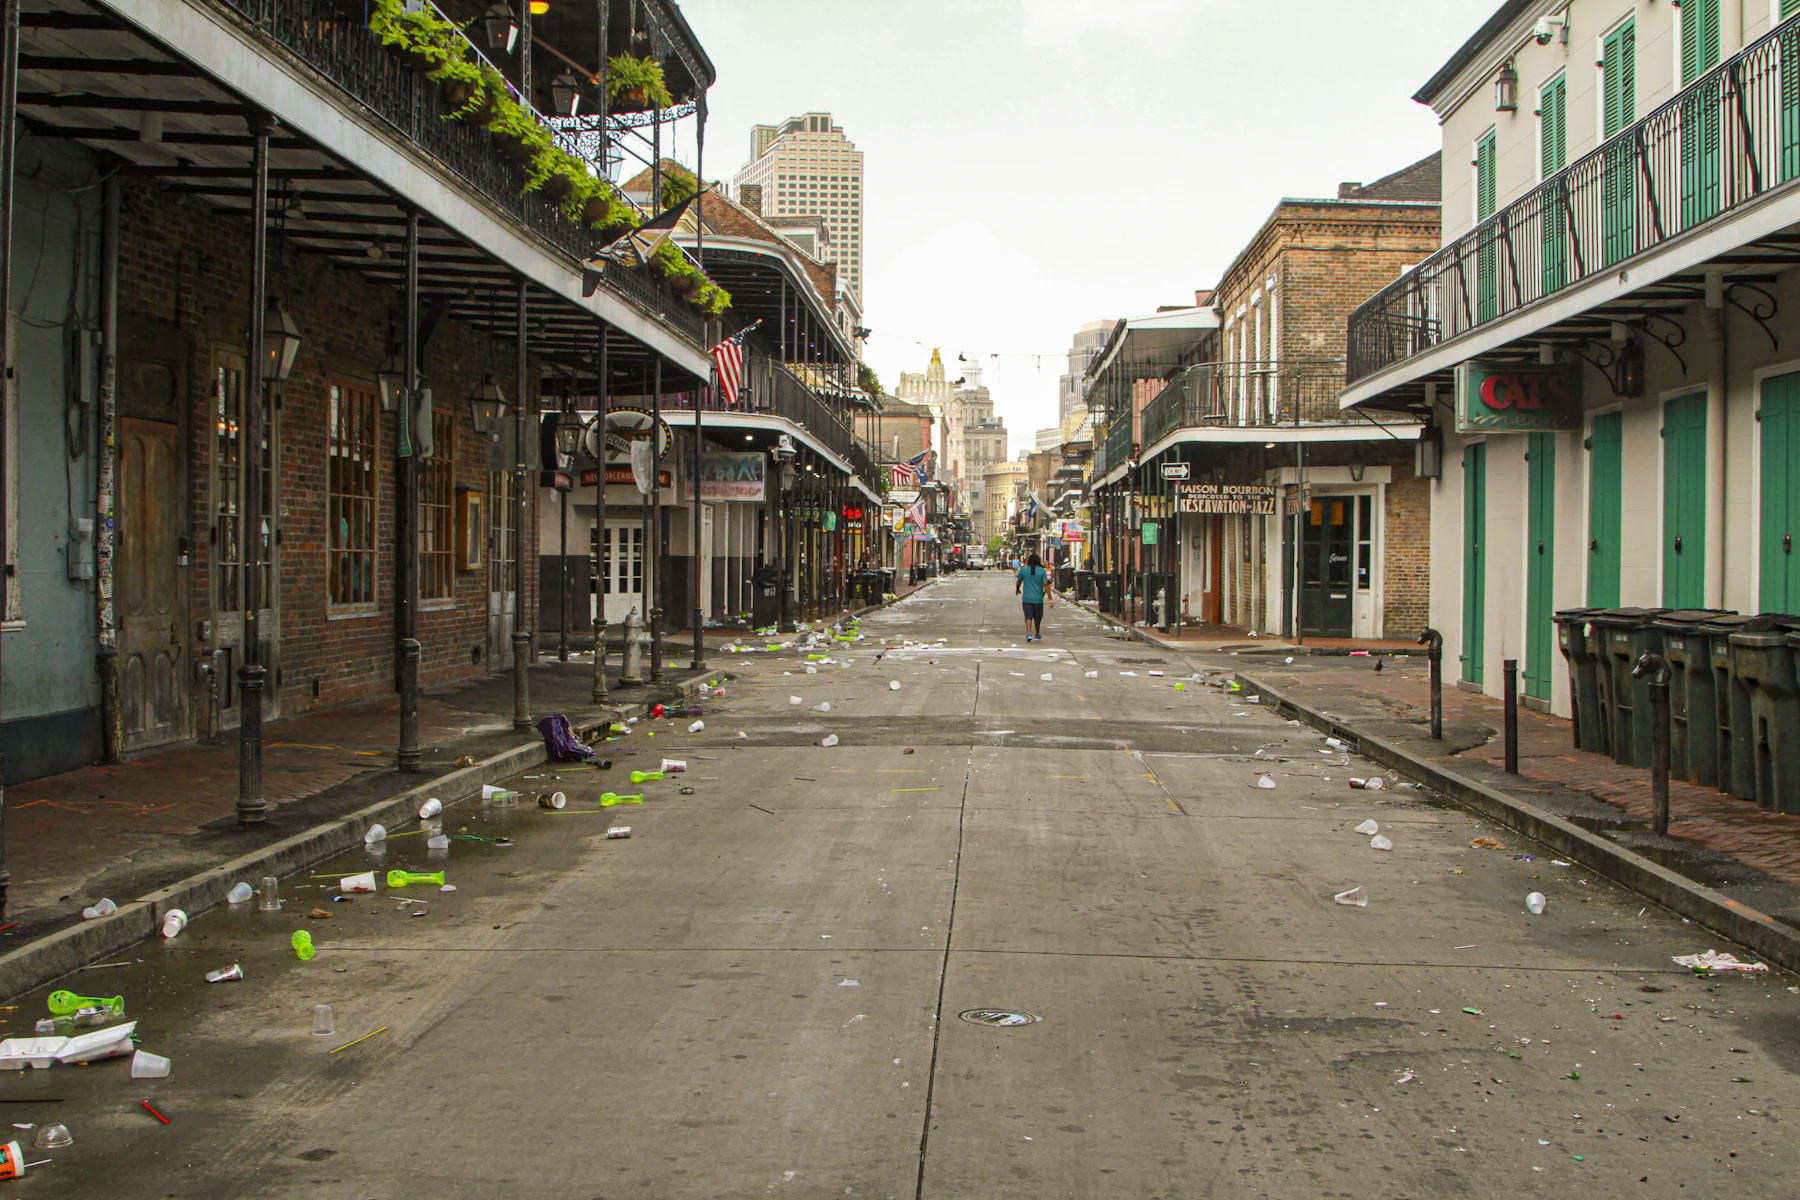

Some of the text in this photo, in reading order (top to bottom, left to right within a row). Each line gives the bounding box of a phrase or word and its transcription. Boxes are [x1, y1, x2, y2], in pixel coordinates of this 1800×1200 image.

[1480, 374, 1570, 409] CATS
[604, 472, 635, 480] ORLEANS
[1174, 484, 1275, 495] MAISON BOURBON
[1250, 497, 1275, 514] JAZZ
